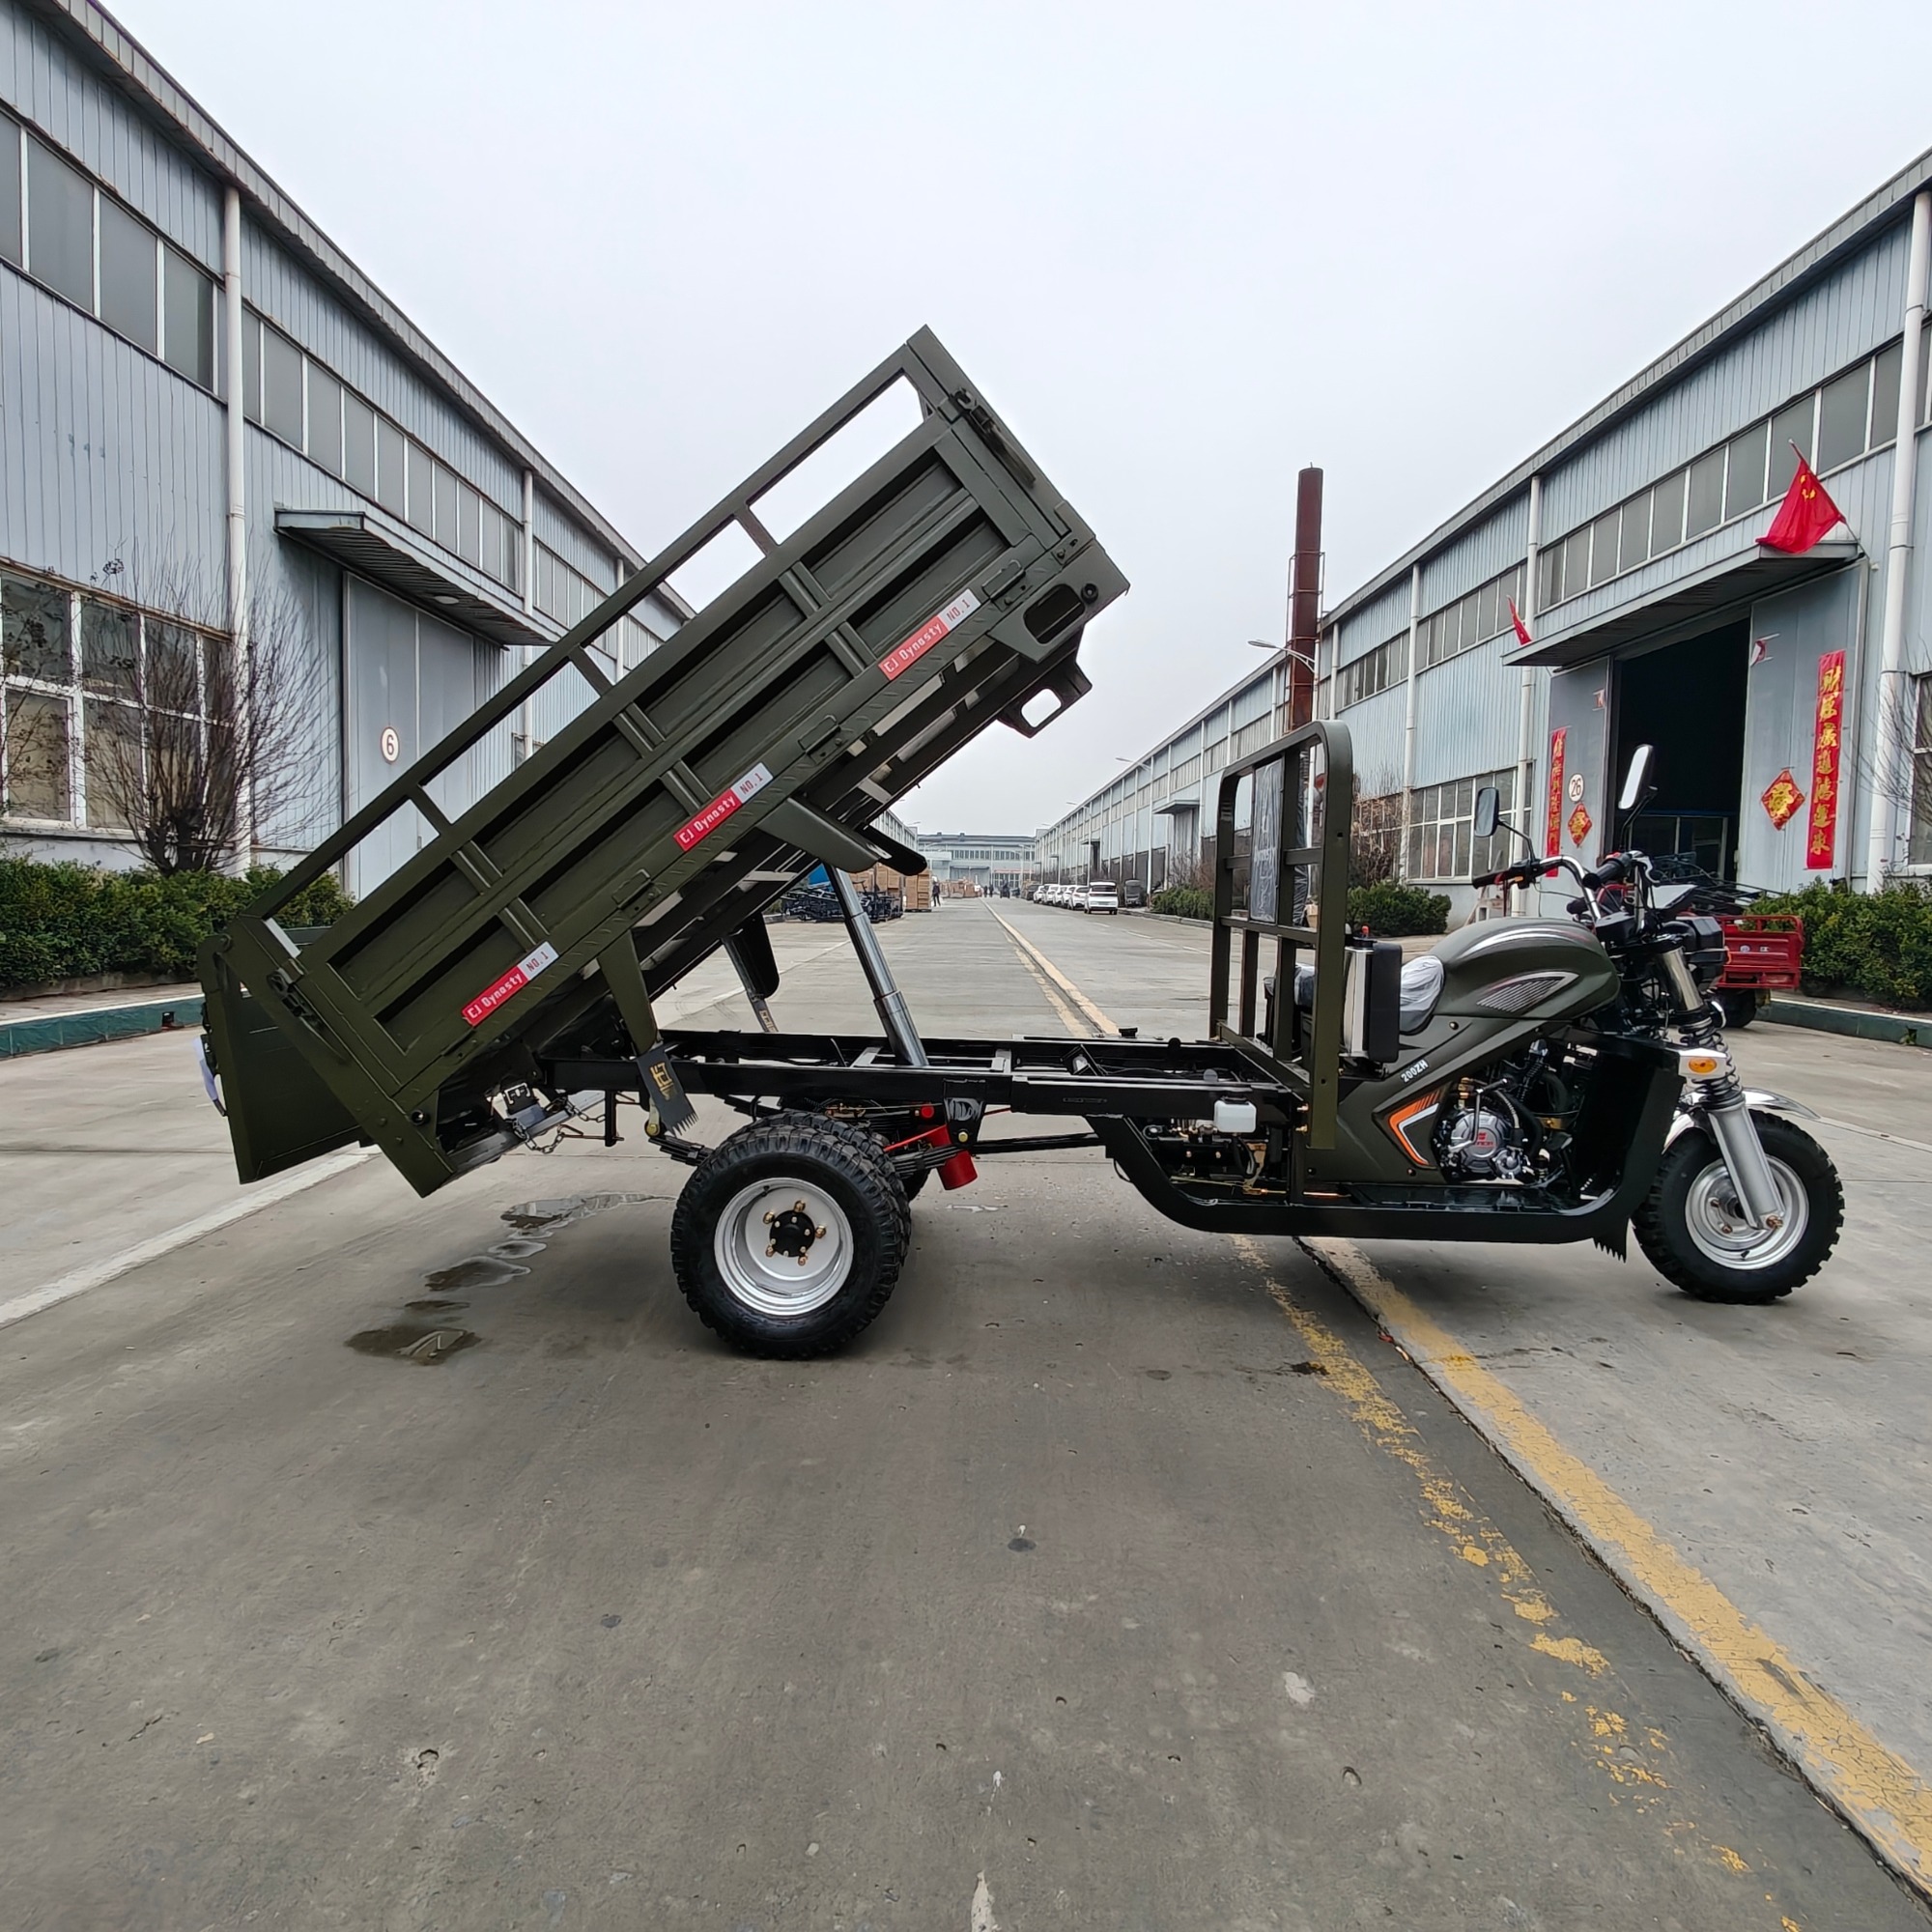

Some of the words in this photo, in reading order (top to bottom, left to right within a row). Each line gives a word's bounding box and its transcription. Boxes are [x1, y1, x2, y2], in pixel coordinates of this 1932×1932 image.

[883, 657, 899, 672] CJ
[898, 623, 943, 660] Dynasty
[385, 733, 395, 755] 6
[1570, 778, 1581, 798] 26
[679, 828, 695, 843] CJ
[694, 796, 736, 832] Dynasty
[467, 1004, 482, 1019] CJ
[481, 973, 523, 1008] Dynasty
[1401, 1059, 1429, 1083] 200ZH
